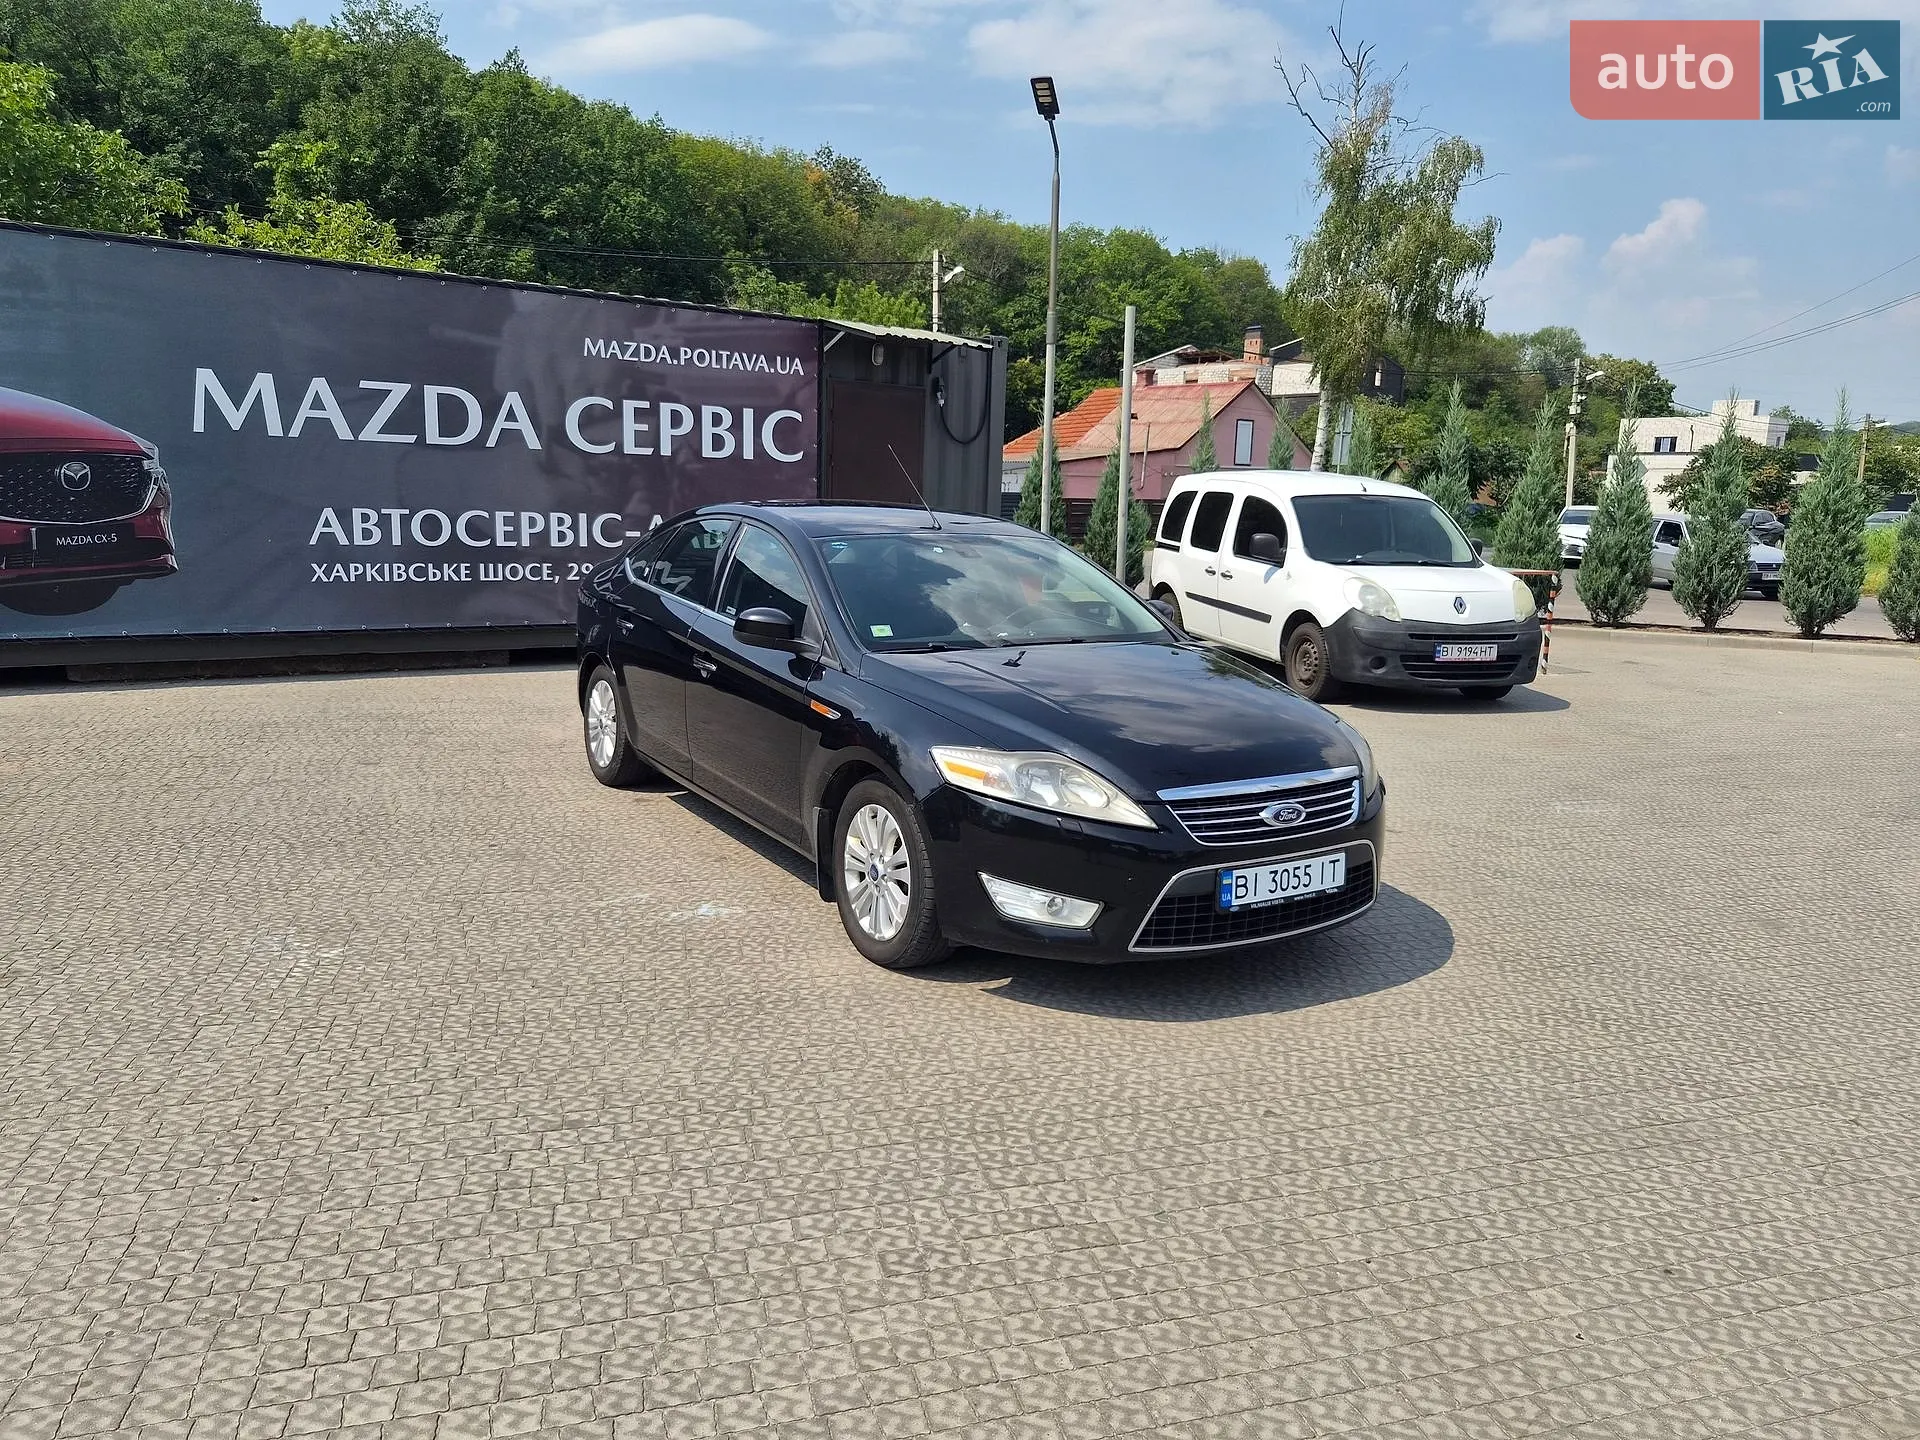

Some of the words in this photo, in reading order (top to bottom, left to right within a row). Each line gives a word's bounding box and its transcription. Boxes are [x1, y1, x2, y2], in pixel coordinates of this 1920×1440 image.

[583, 337, 804, 375] MAZDA.POLTAVA.UA
[193, 367, 543, 450] MAZDA
[565, 396, 804, 463] СЕРВІС
[56, 535, 93, 546] MAZDA
[94, 533, 117, 544] CX-5
[311, 563, 472, 582] ХАРКІВСЬКЕ
[479, 563, 560, 584] ШОСЕ,
[1279, 809, 1297, 821] Ford
[1234, 873, 1258, 900] BI
[1268, 863, 1312, 894] 3055
[1320, 858, 1341, 886] IT
[1222, 892, 1232, 902] UA
